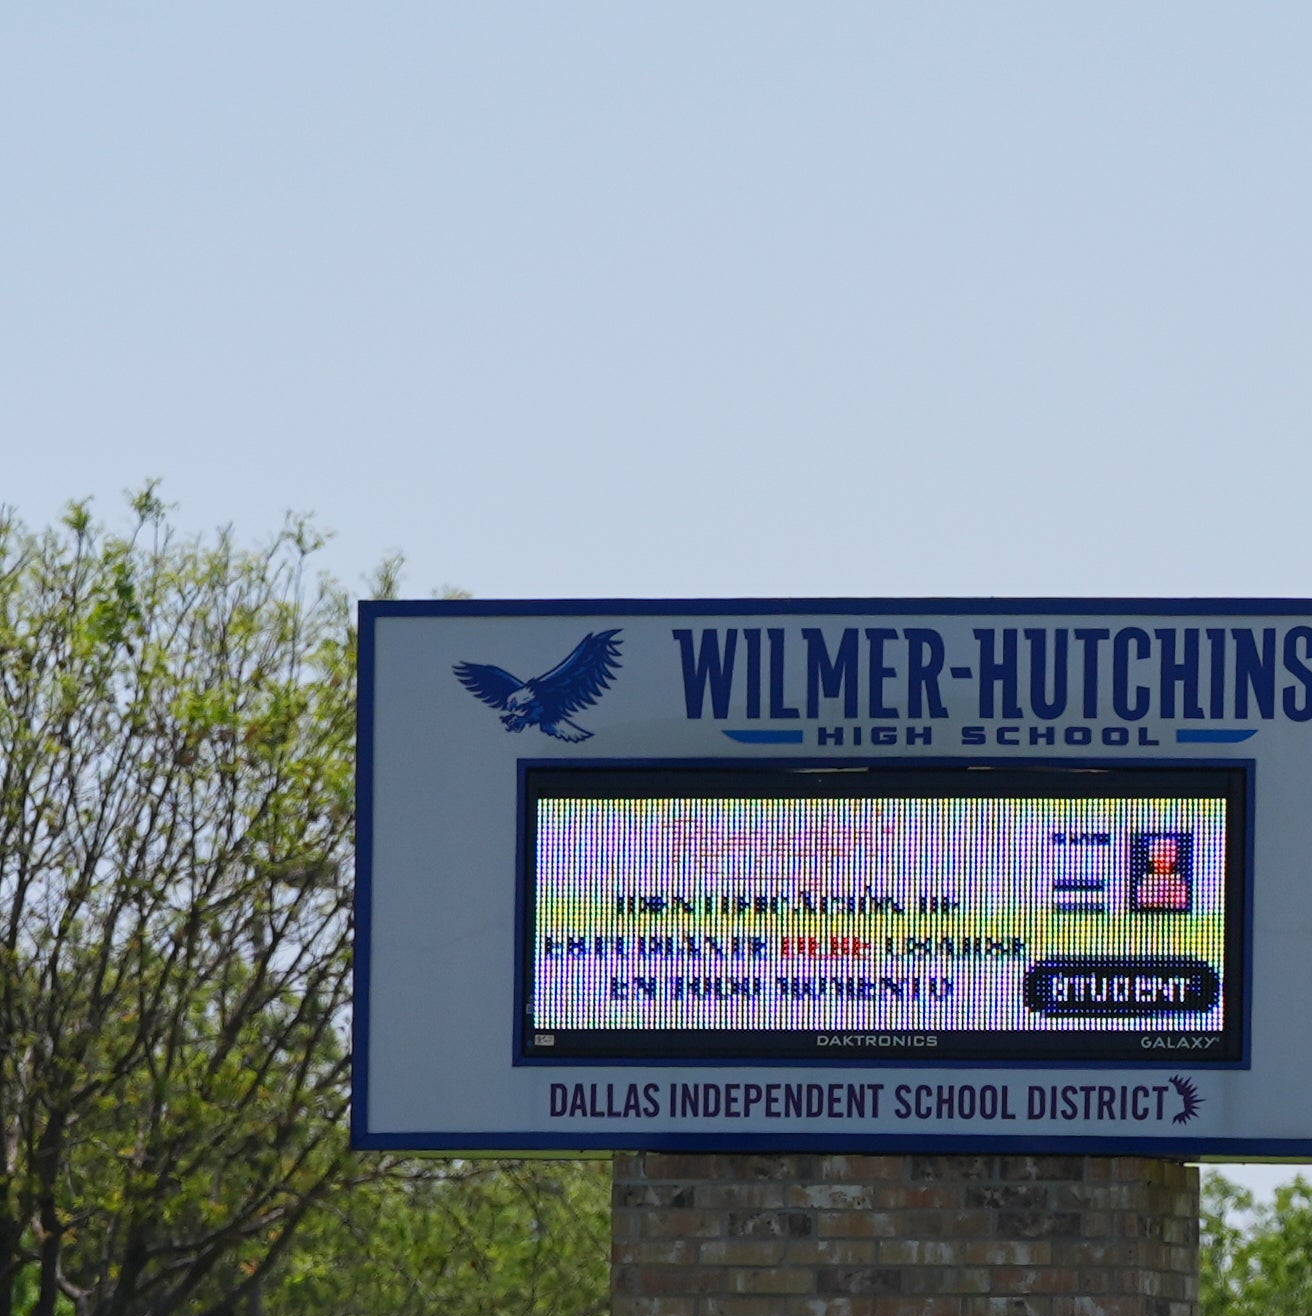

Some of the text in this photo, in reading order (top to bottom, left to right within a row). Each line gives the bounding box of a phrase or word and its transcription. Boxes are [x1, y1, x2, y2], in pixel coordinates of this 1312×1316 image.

[818, 726, 1160, 747] HIGH SCHOOL
[1051, 972, 1191, 1002] STUDENT
[816, 1034, 939, 1047] DAKTRONICS
[550, 1083, 1169, 1121] DALLAS INDEPENDENT SCHOOL DISTRICT
